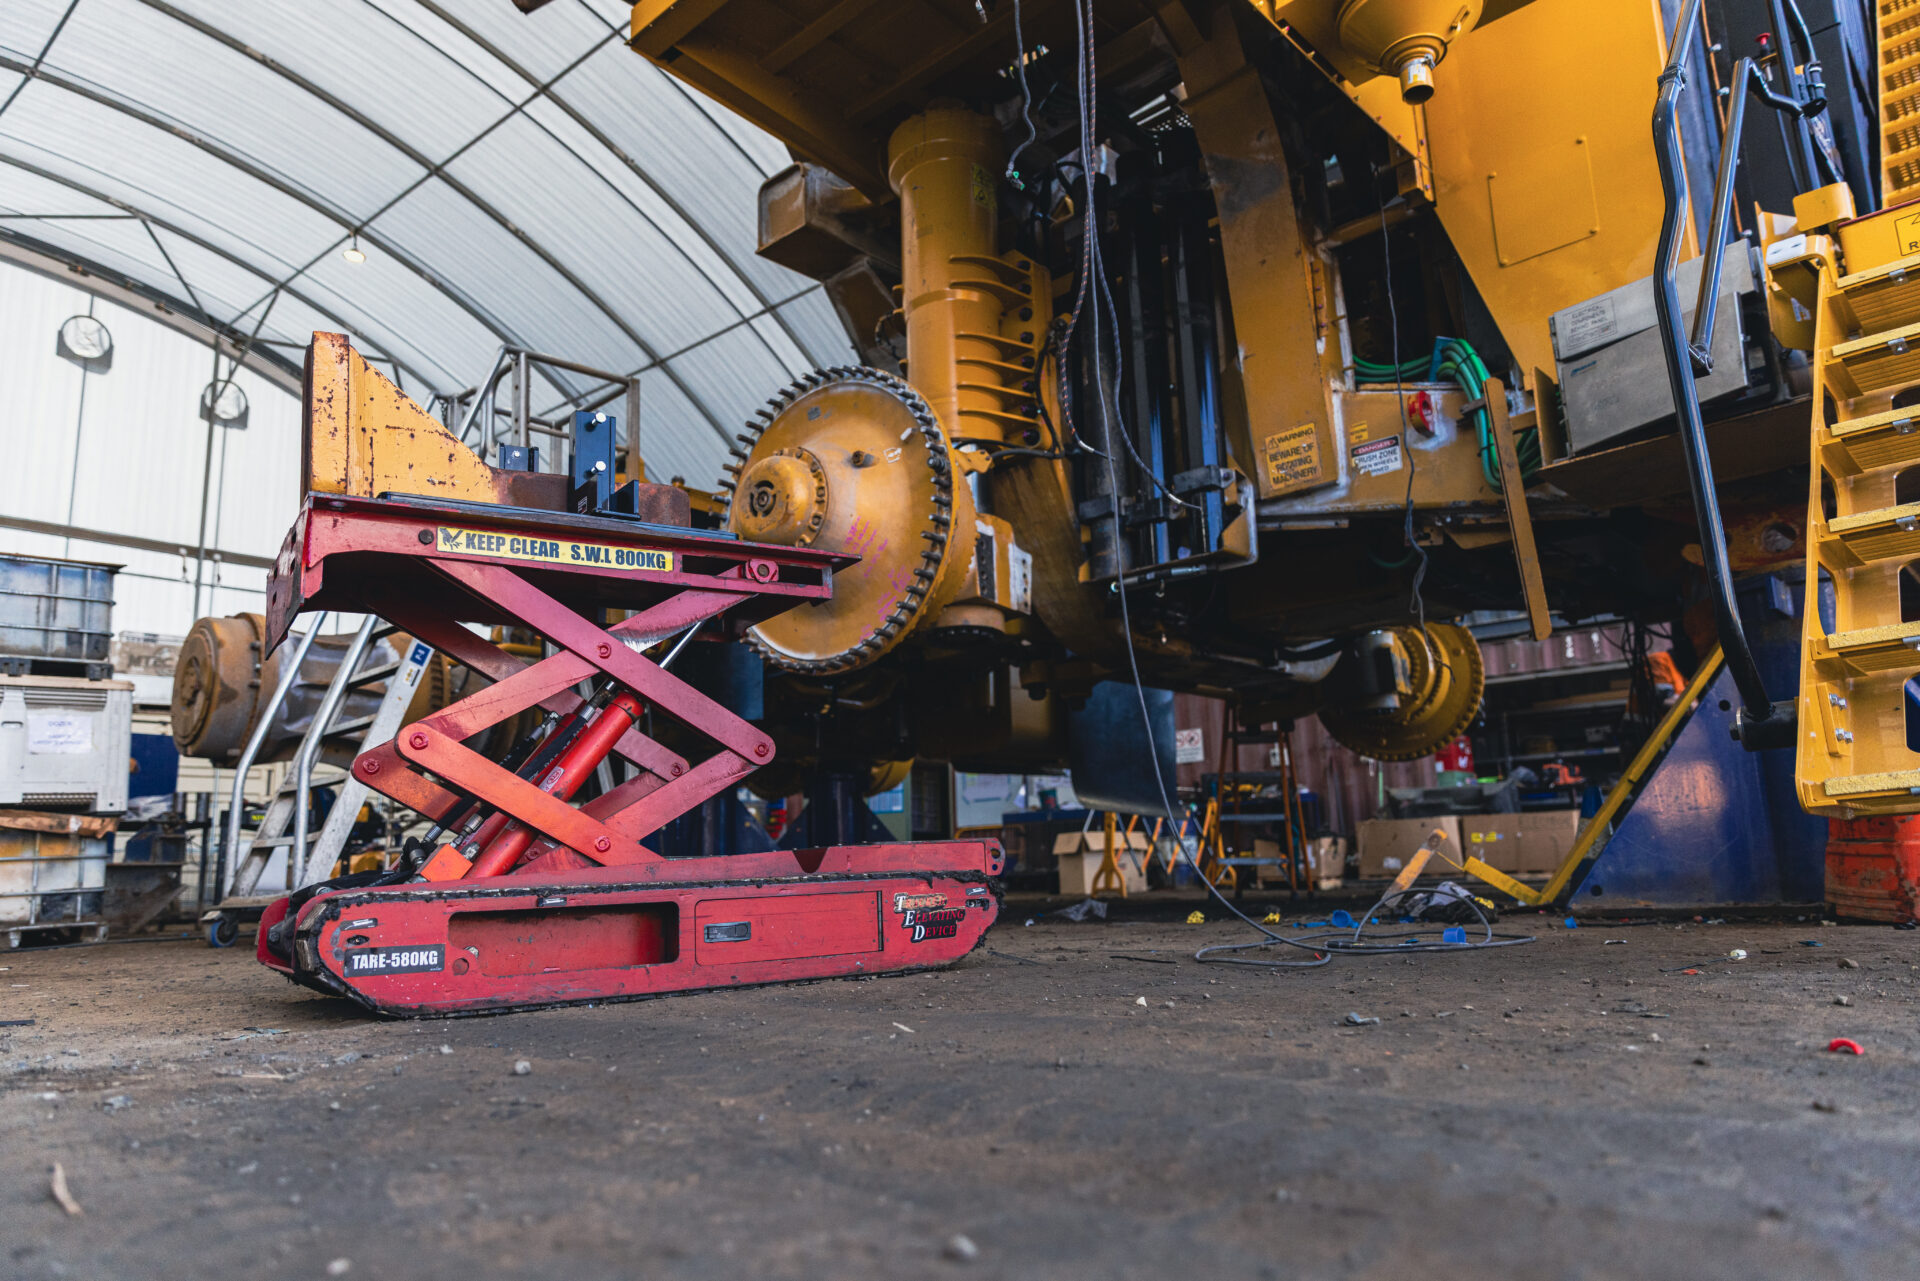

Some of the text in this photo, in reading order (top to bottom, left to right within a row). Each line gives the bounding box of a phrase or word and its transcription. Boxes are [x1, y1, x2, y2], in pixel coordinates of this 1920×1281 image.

[1277, 427, 1314, 444] WARNING
[1269, 446, 1301, 463] BEWARE
[1379, 447, 1398, 460] ZONE
[1272, 465, 1318, 484] MACHINERY
[465, 532, 667, 570] KEEP CLEAR S.W.L 800KG
[913, 924, 956, 941] DEVICE
[352, 950, 438, 970] TARE-580KG
